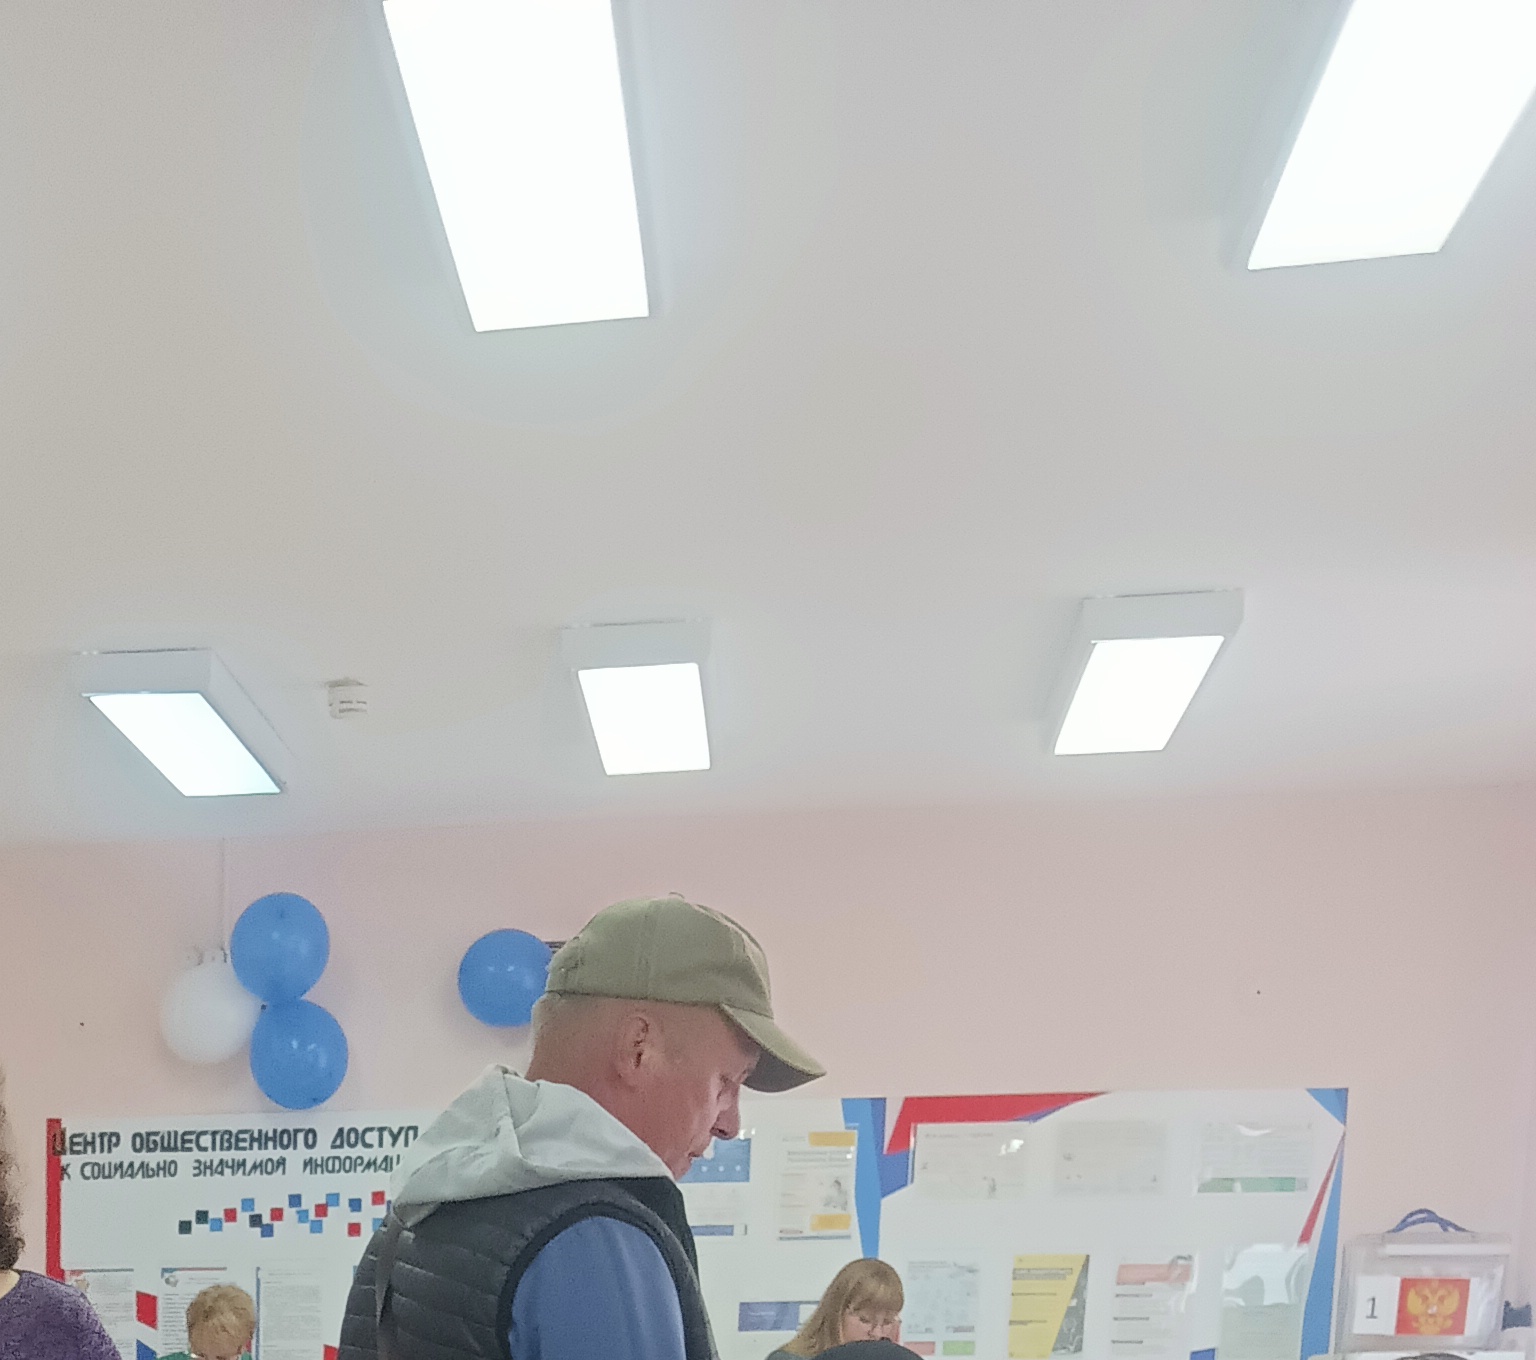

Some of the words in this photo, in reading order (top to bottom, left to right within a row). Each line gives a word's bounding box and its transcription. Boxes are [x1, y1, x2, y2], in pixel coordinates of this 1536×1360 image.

[52, 1127, 121, 1156] ЦЕНТР
[131, 1128, 318, 1153] ОБЩЕСТВЕННОГО
[330, 1125, 419, 1151] ДОСТУП
[80, 1159, 178, 1181] СОЦИАЛЬНО
[192, 1156, 287, 1178] ЗНАЧИМОЙ
[1366, 1297, 1378, 1319] 1
